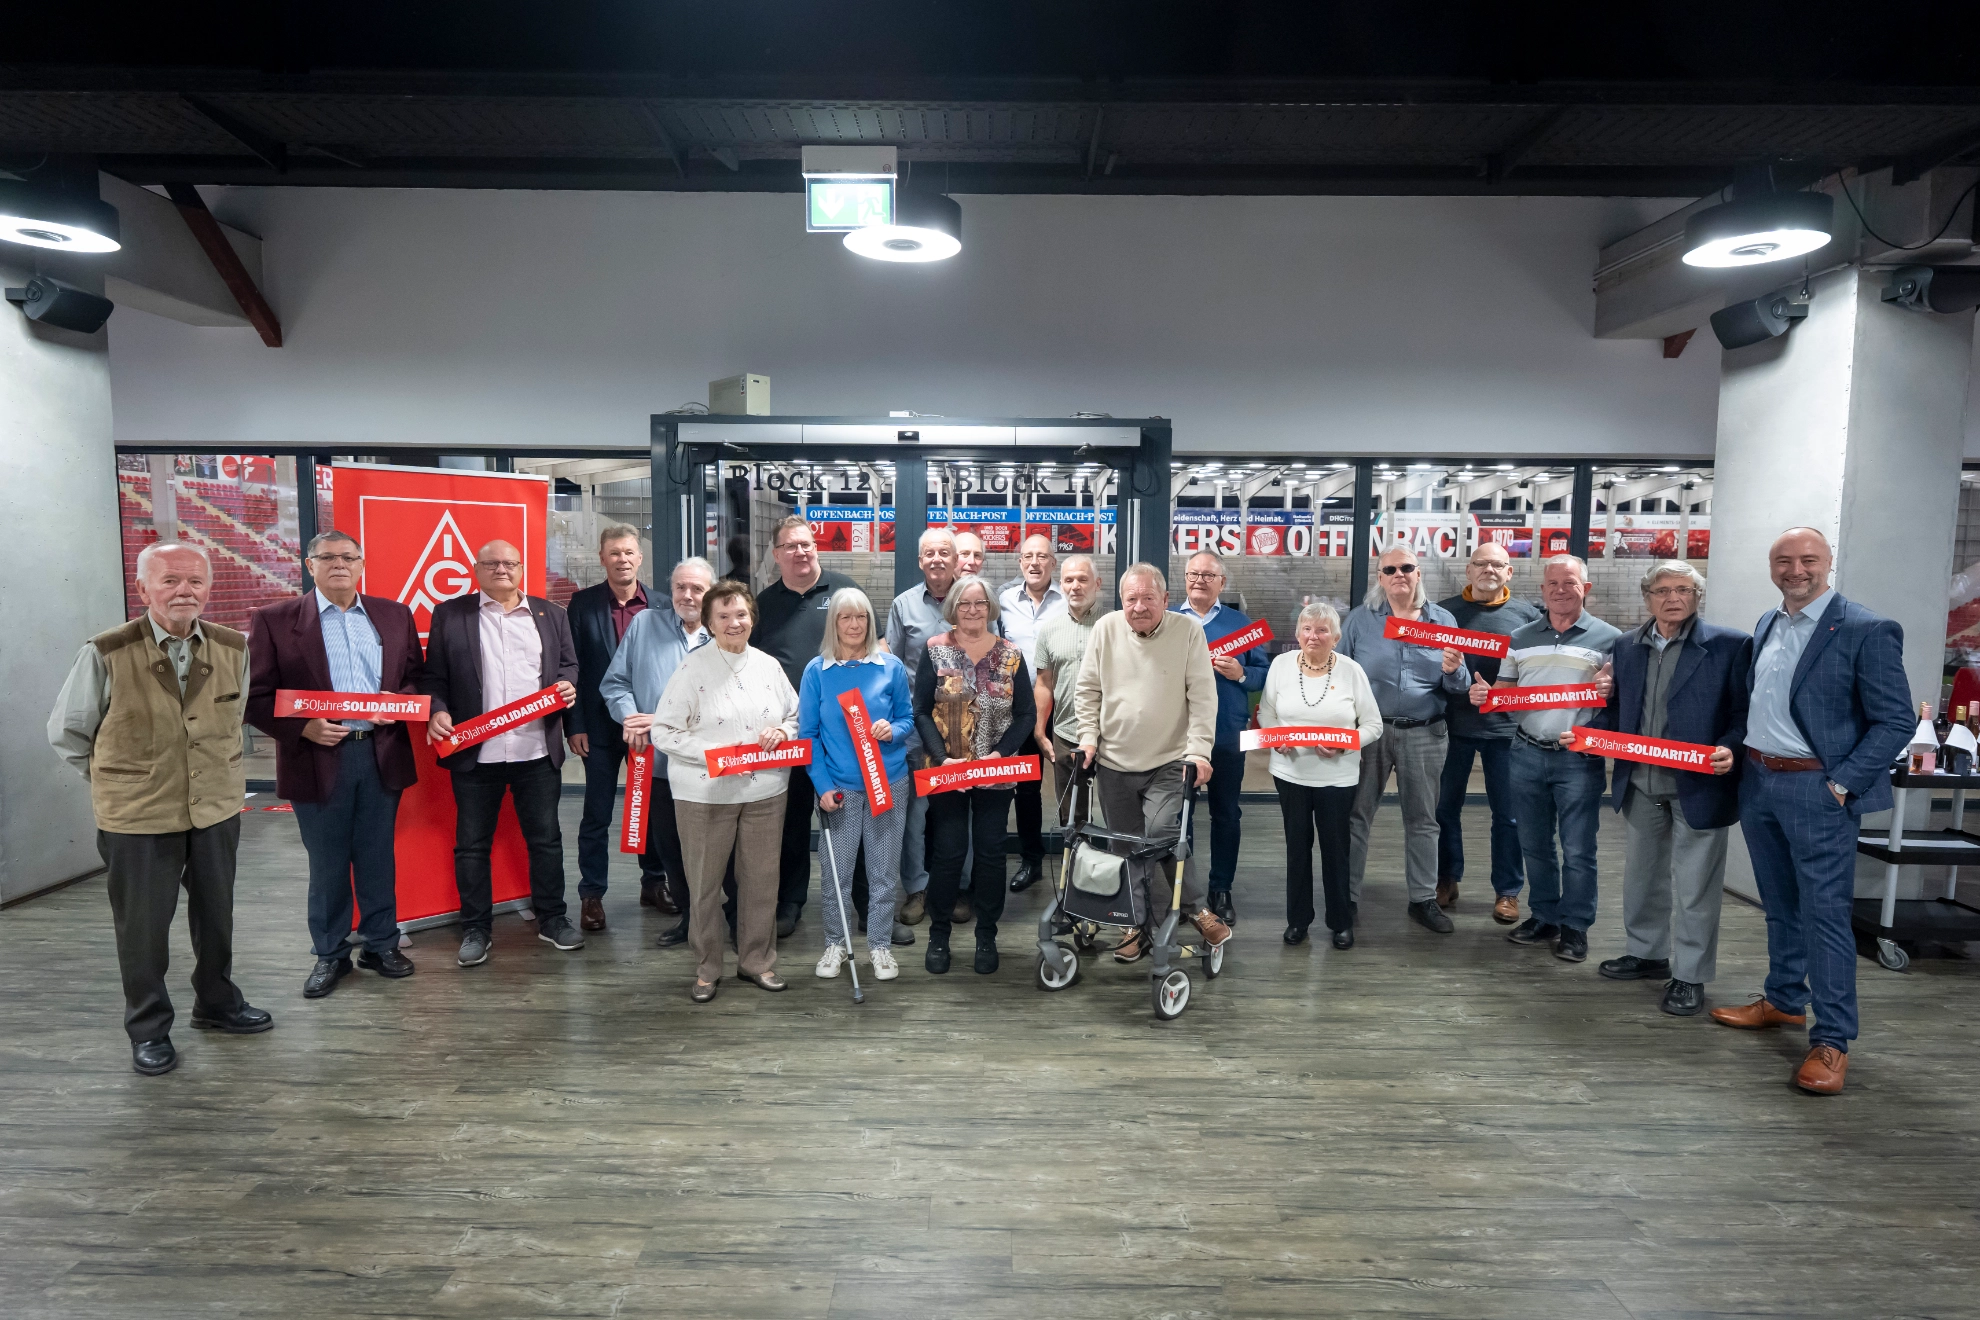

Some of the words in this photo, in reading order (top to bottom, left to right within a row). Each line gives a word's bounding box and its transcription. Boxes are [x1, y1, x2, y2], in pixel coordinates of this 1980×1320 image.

[729, 463, 826, 491] Block
[841, 471, 871, 491] 12
[953, 465, 1051, 493] Block
[1064, 474, 1091, 493] 11
[810, 510, 895, 519] OFFENBACH-OS
[927, 511, 1008, 520] FENBACH-POST
[1026, 512, 1114, 521] OFFENBACH-PST
[1173, 514, 1218, 523] eidenschaft,
[852, 523, 864, 548] 1921
[1491, 528, 1514, 547] 1970
[1550, 541, 1567, 551] 1974
[1398, 625, 1502, 651] #50JahreSOLIDARITÄT
[294, 698, 422, 714] #50JahreSOLIDARITÄT
[1492, 689, 1598, 706] #50JahreSOLIDARITÄT
[450, 694, 556, 745] #50JahreSOLIDARITÄT
[1256, 732, 1353, 744] 50JahreSOLIDARITÄT
[849, 705, 886, 806] #50JahreSOLIDARITÄT
[1585, 736, 1705, 765] #50JahreSOLIDARITÄT
[929, 762, 1033, 787] #50JahreSOLIDARITÄT
[628, 756, 645, 848] #50JahreSOLIDARITÄT
